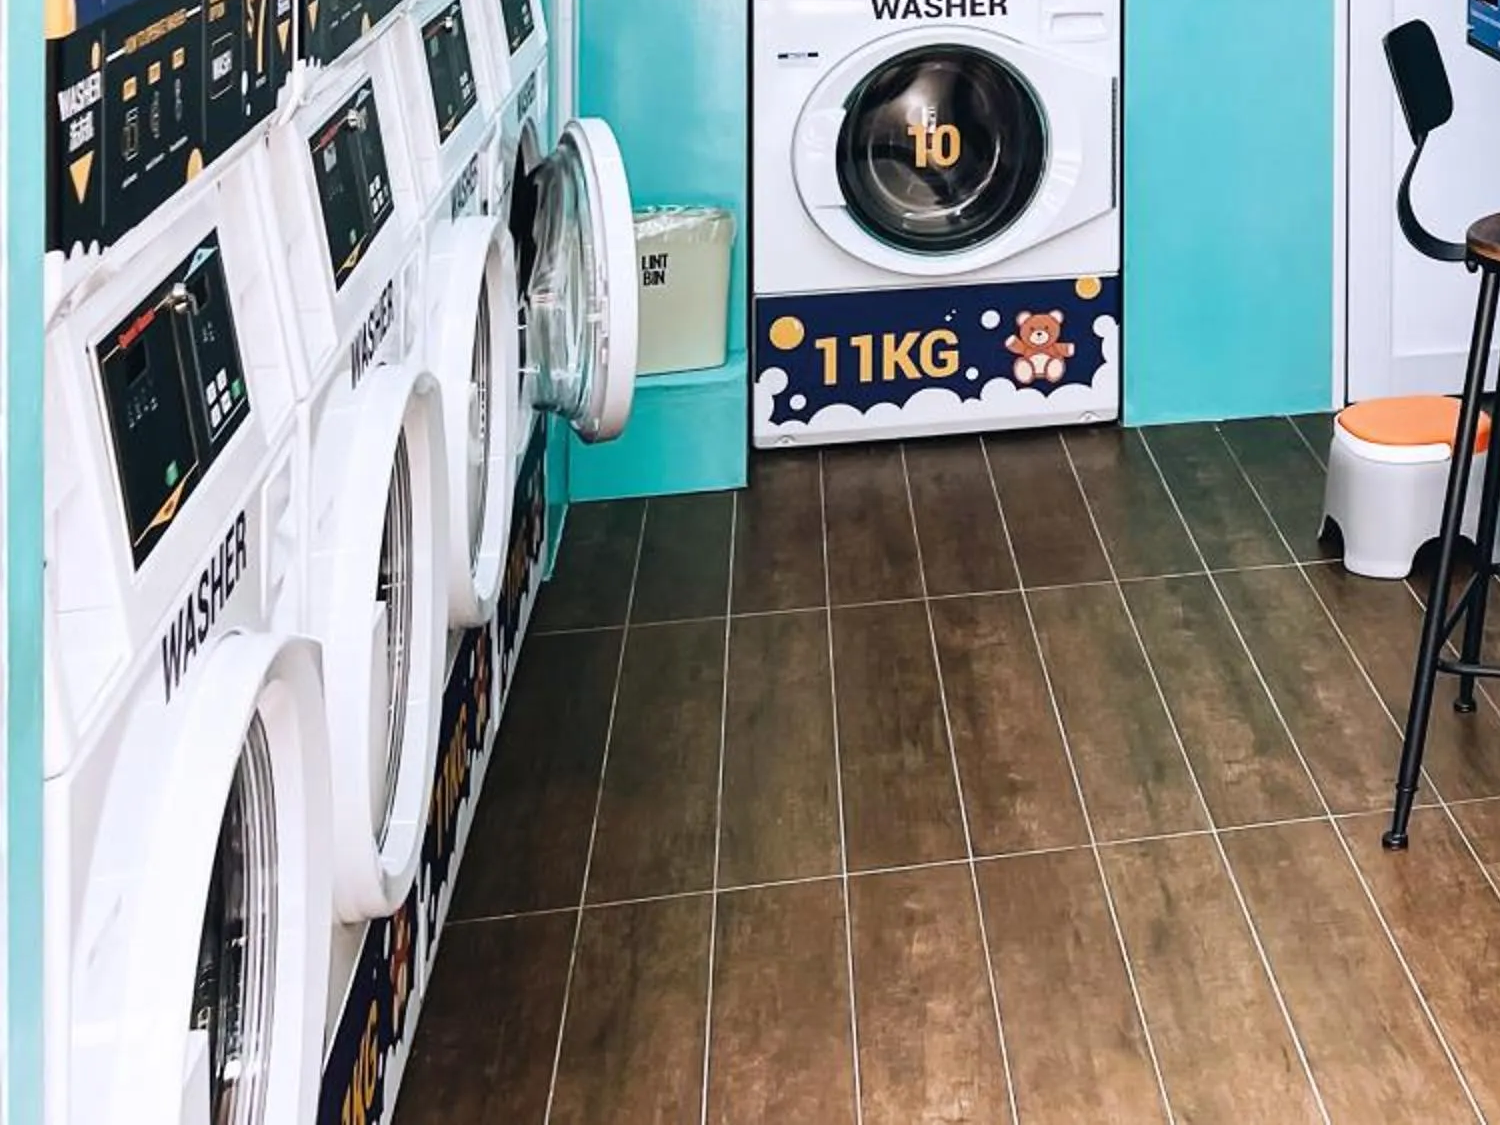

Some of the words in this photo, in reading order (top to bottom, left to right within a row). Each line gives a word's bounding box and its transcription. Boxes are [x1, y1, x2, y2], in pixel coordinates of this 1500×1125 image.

[907, 124, 962, 169] 10
[641, 253, 669, 270] LINT
[643, 270, 666, 286] BIN
[351, 278, 395, 391] WASHER
[814, 327, 960, 386] 11KG
[159, 508, 248, 706] WASHER
